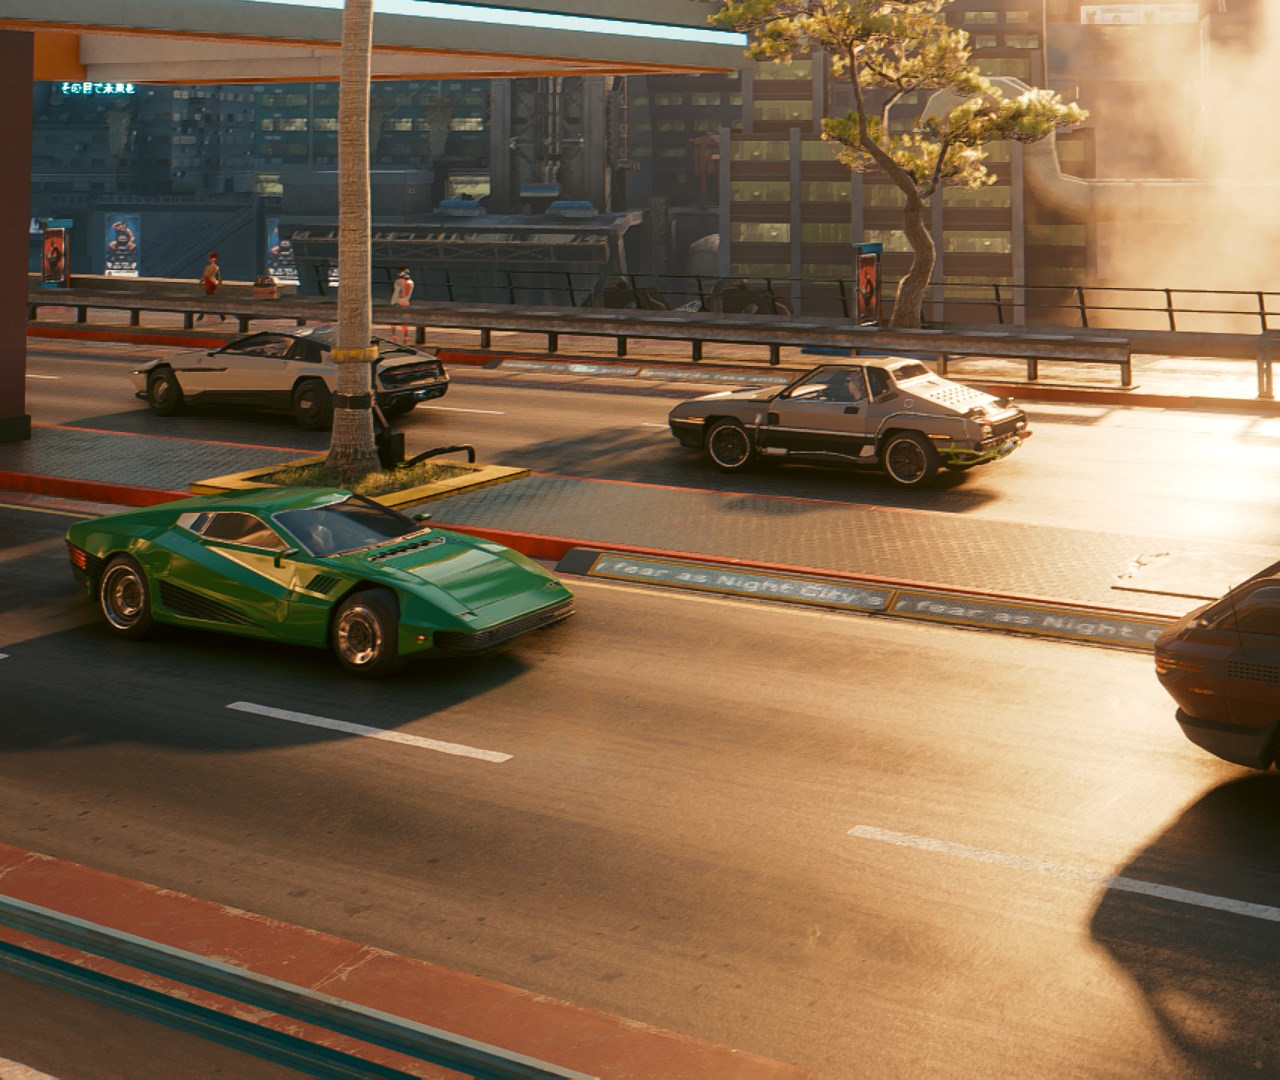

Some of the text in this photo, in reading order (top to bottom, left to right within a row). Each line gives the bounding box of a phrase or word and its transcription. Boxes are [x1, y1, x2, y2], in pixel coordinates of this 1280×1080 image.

[675, 571, 708, 584] as
[718, 574, 794, 593] Night
[917, 600, 984, 617] fear
[994, 612, 1031, 626] as
[1041, 616, 1139, 637] Night
